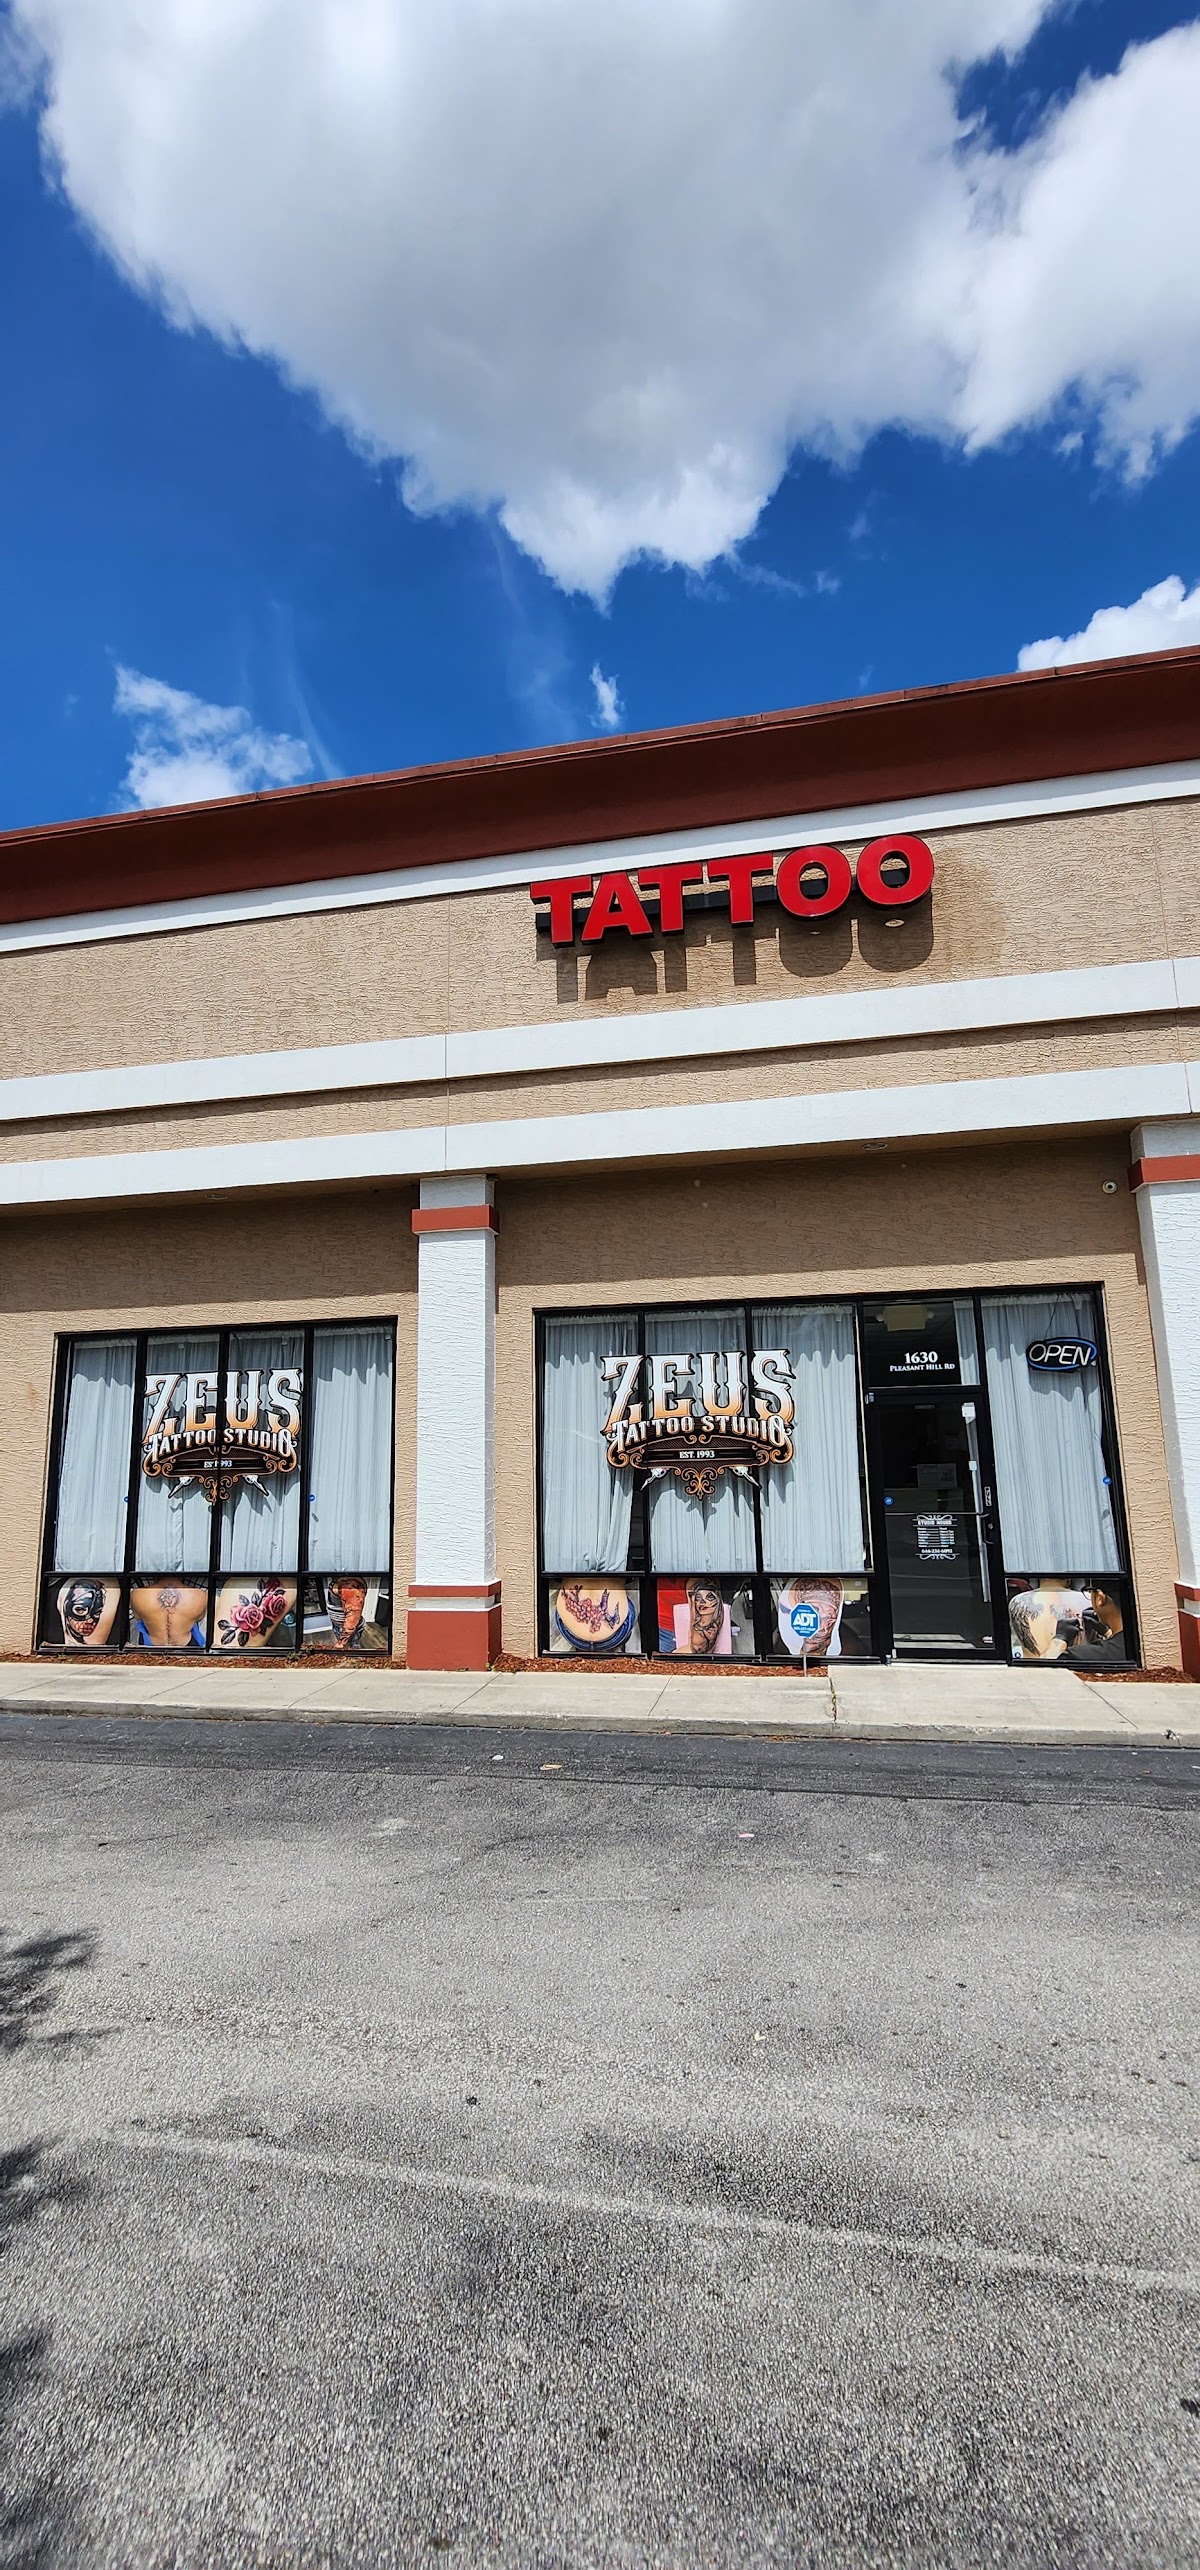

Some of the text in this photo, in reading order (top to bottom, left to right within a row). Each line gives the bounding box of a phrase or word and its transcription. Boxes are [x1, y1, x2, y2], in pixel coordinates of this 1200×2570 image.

[530, 834, 935, 946] TATTOO
[889, 1364, 925, 1372] PLEASANT
[925, 1363, 943, 1371] HILL
[904, 1351, 938, 1364] 1630
[1029, 1344, 1091, 1366] OPEN
[142, 1368, 303, 1444] ZEUS
[600, 1349, 797, 1436] ZEUS
[148, 1428, 293, 1463] TATTOO STUDIO
[611, 1414, 785, 1453] TATTOO STUDIO
[679, 1450, 716, 1459] EST. 1993
[793, 1613, 816, 1627] ADT
